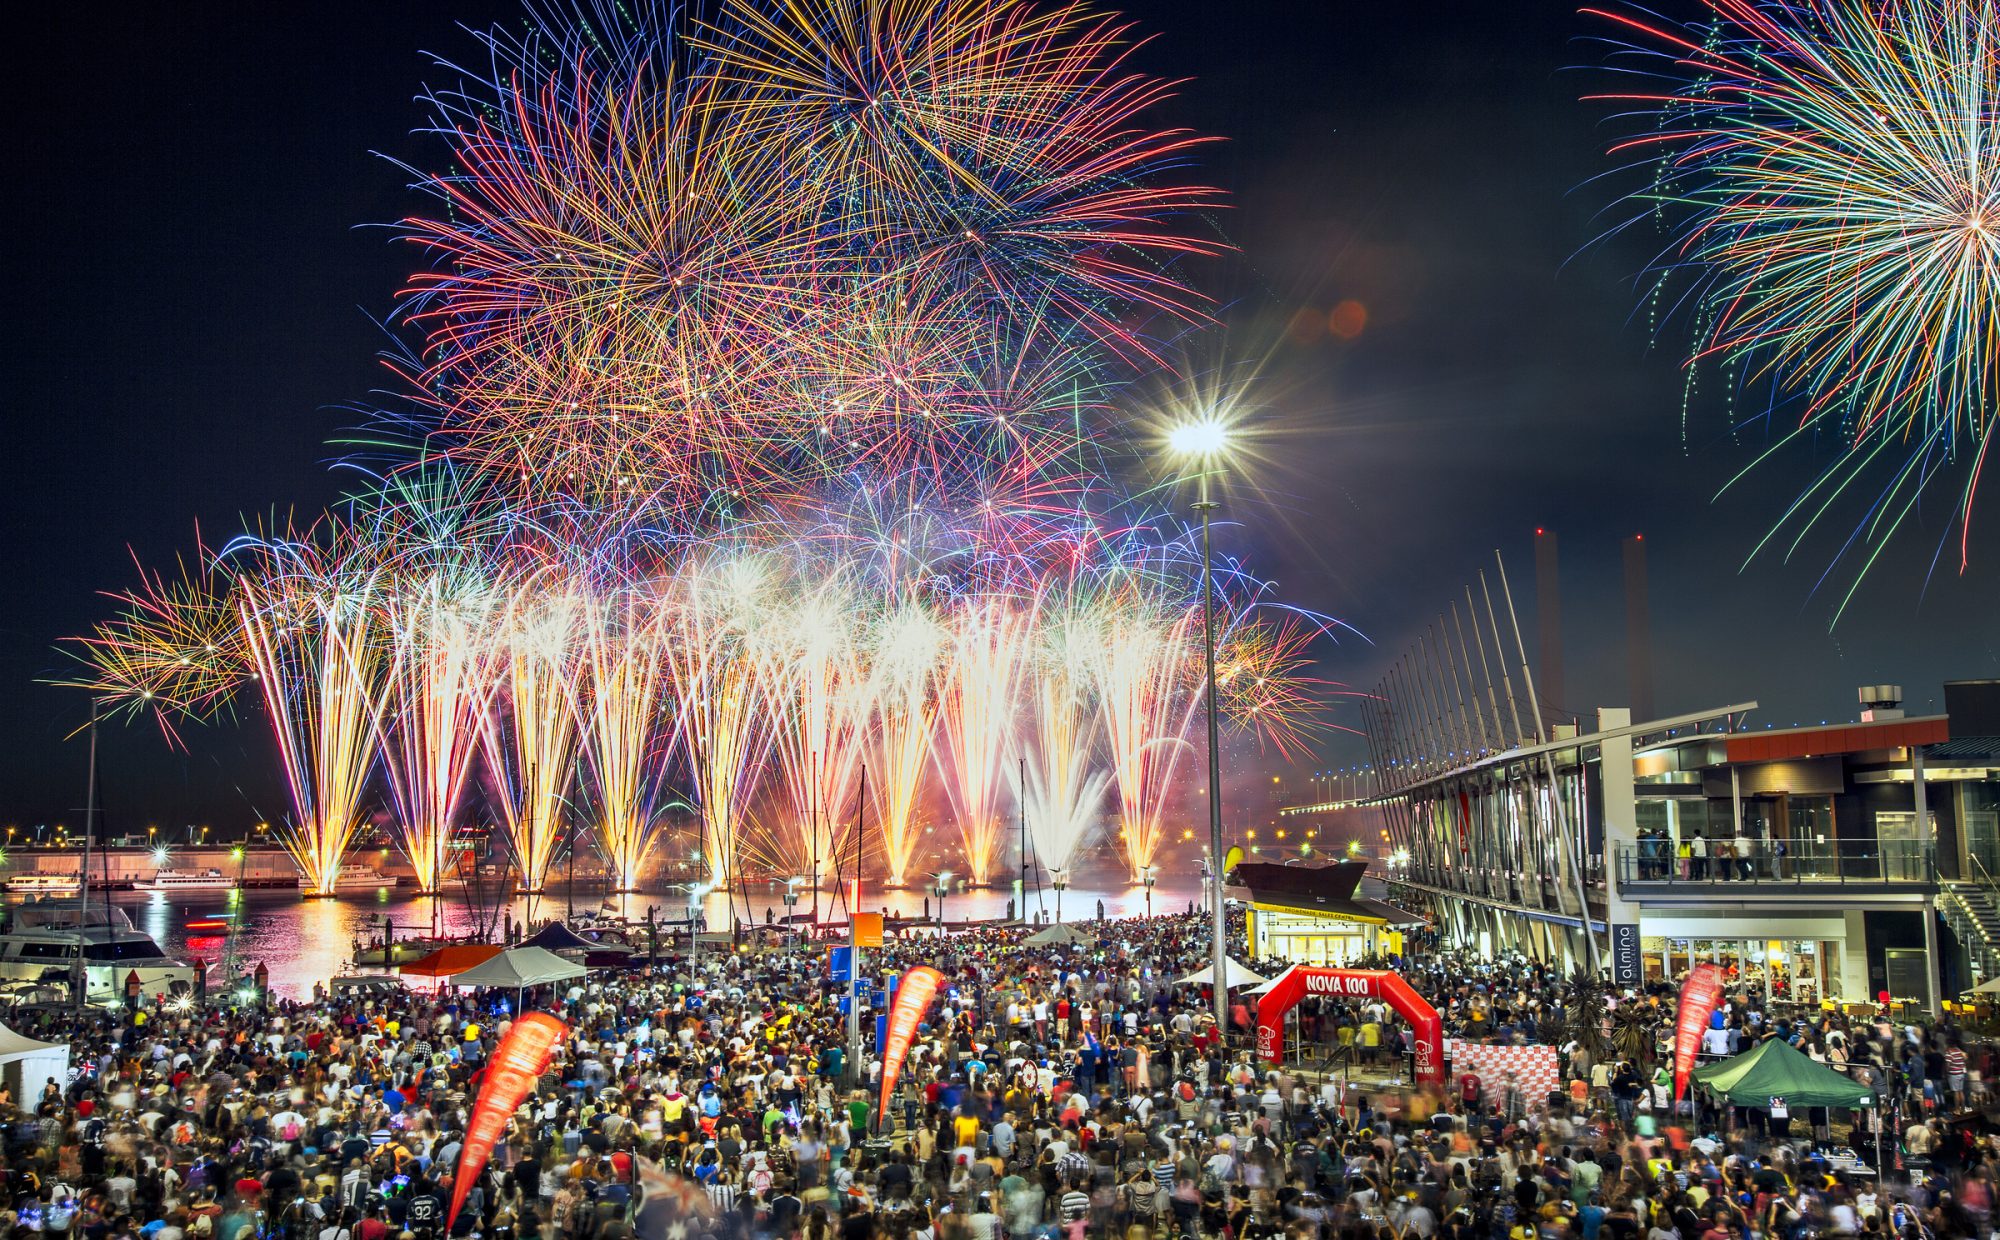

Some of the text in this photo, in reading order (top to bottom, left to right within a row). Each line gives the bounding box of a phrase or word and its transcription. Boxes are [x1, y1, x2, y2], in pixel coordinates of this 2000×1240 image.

[1284, 907, 1316, 916] PROMENADE
[1318, 911, 1334, 919] SALES
[1618, 927, 1632, 979] almina
[1306, 974, 1368, 995] NOVA 100
[414, 1205, 431, 1220] 92
